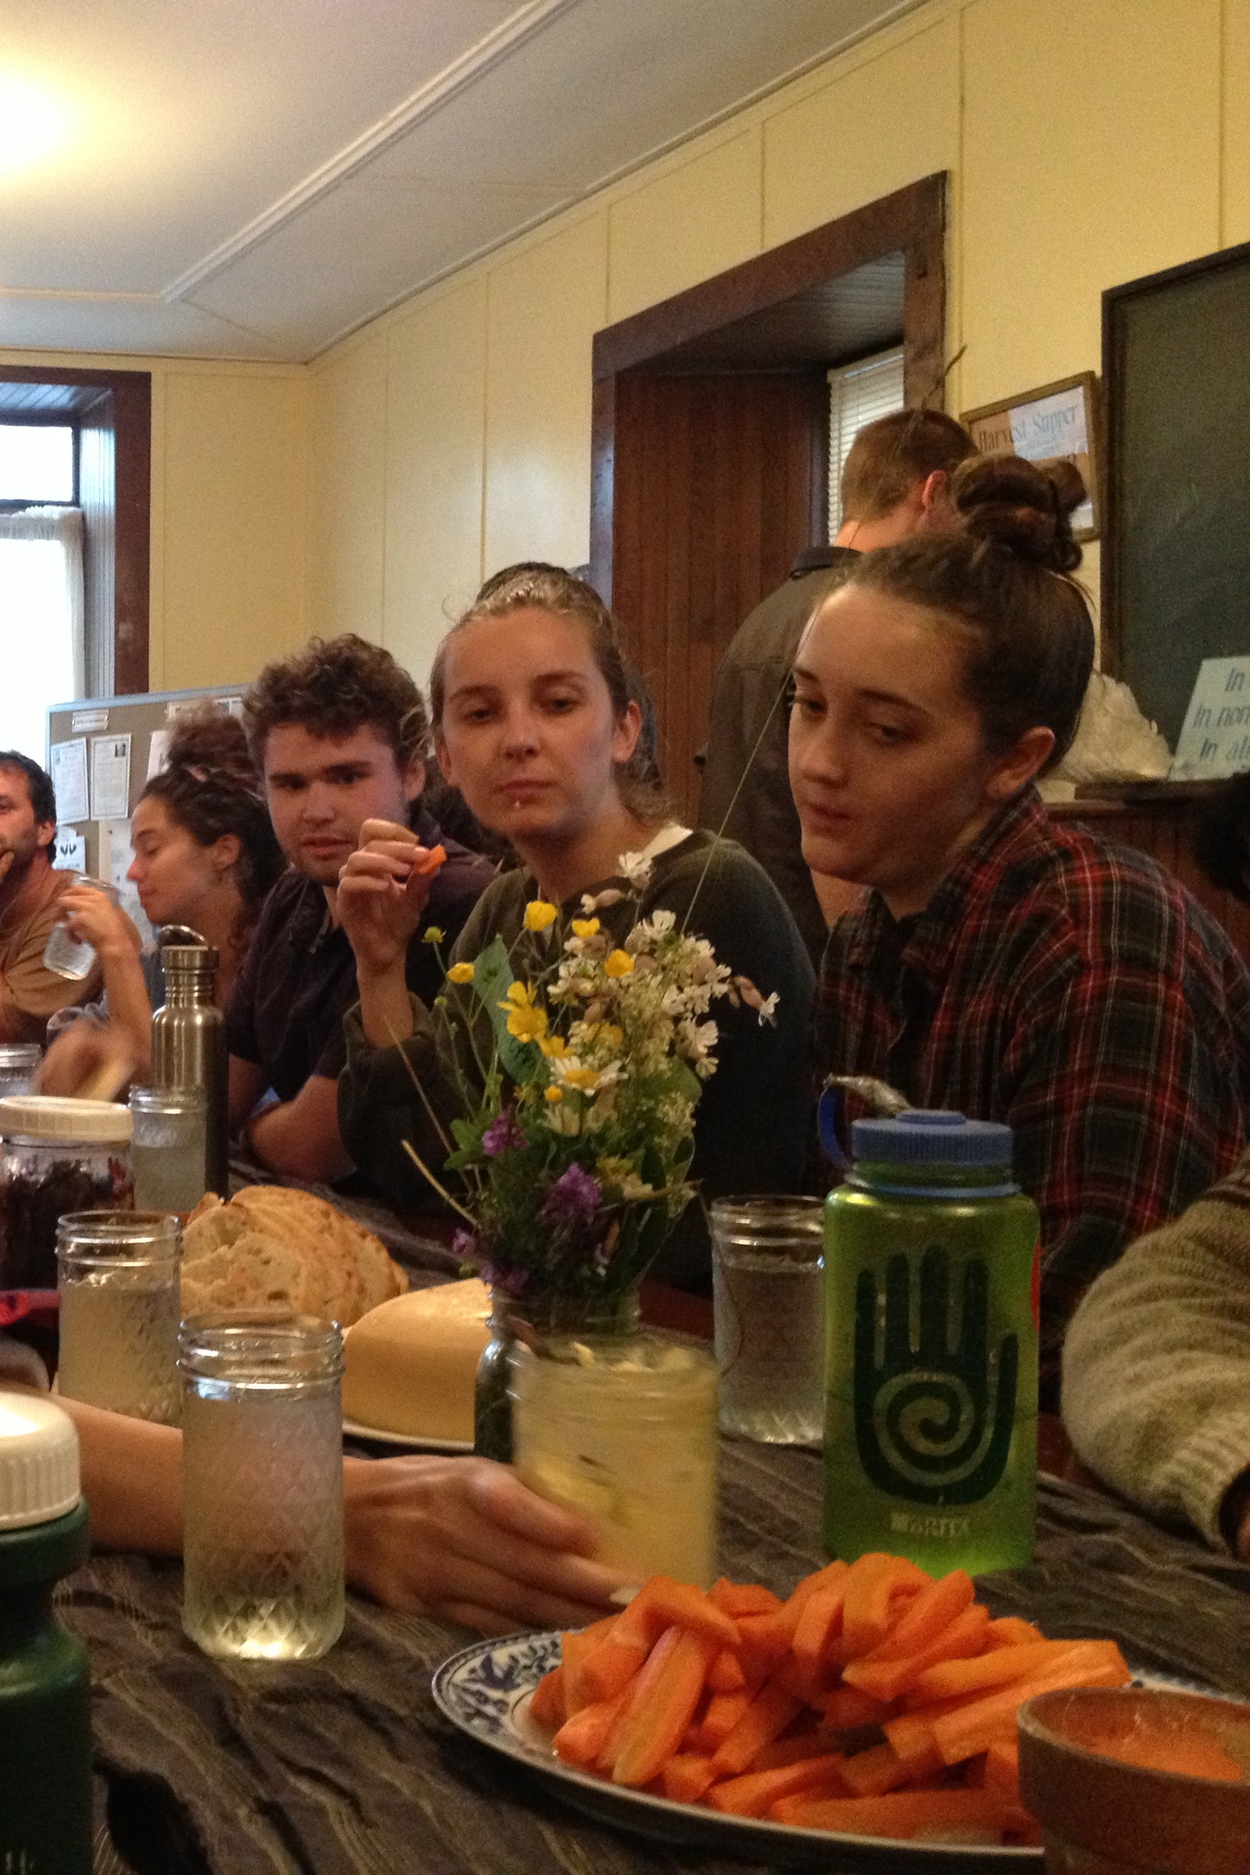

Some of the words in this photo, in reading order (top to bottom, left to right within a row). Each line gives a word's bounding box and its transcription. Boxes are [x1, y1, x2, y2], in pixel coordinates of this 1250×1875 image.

[978, 419, 1027, 453] Harvest
[1224, 667, 1246, 692] In
[1193, 703, 1212, 729] In
[1200, 737, 1218, 761] In
